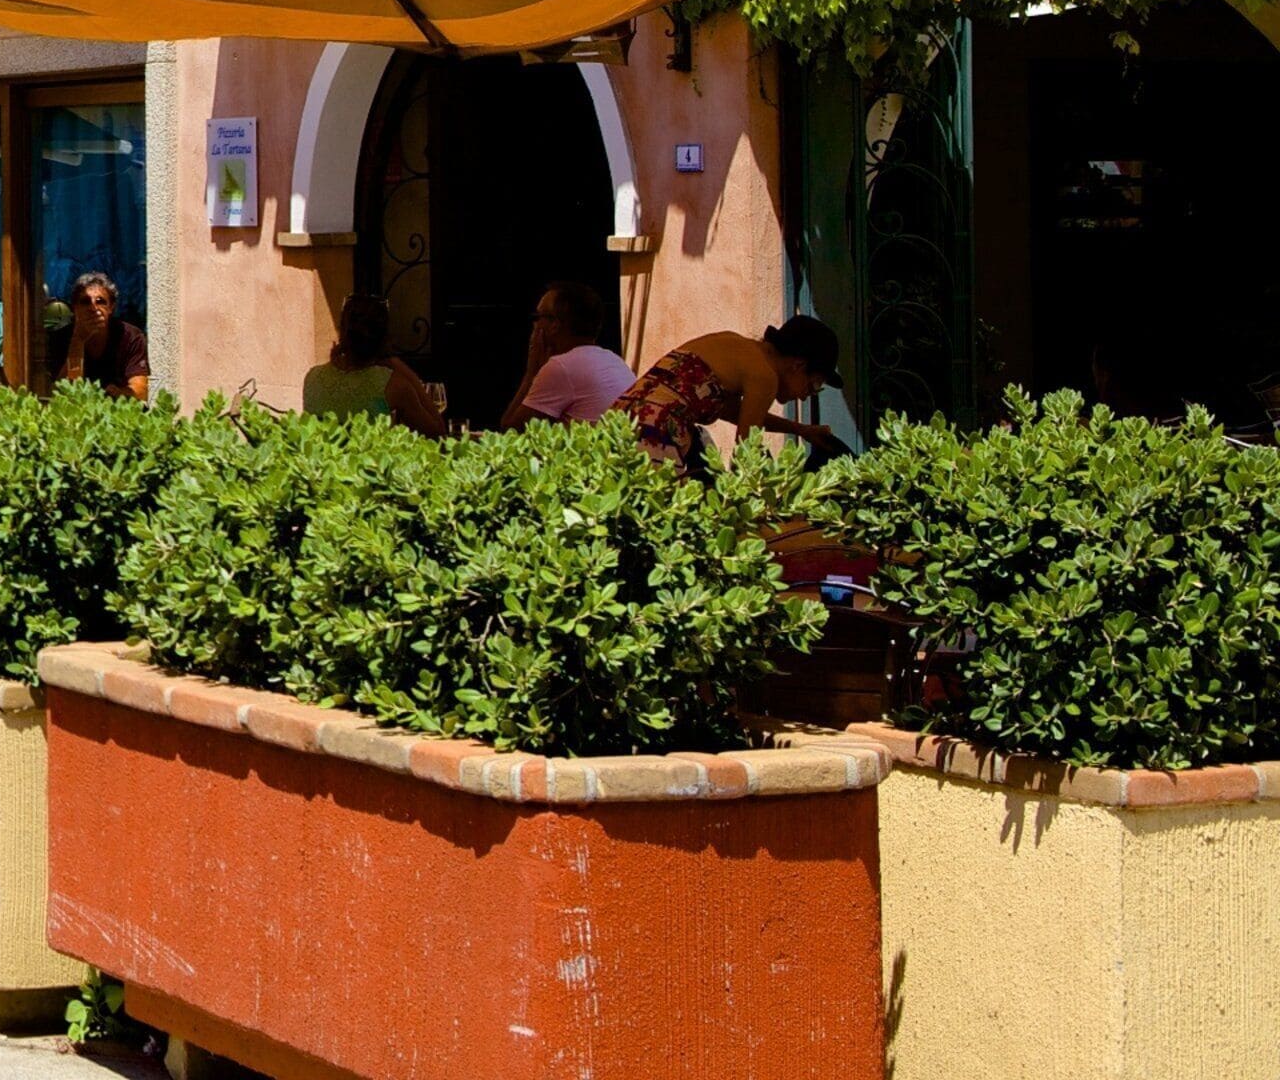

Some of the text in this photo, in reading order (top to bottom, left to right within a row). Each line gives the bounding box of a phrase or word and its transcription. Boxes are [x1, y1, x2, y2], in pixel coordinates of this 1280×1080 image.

[217, 127, 245, 138] Pizzeria
[222, 144, 252, 155] Tartana
[685, 148, 691, 162] 4
